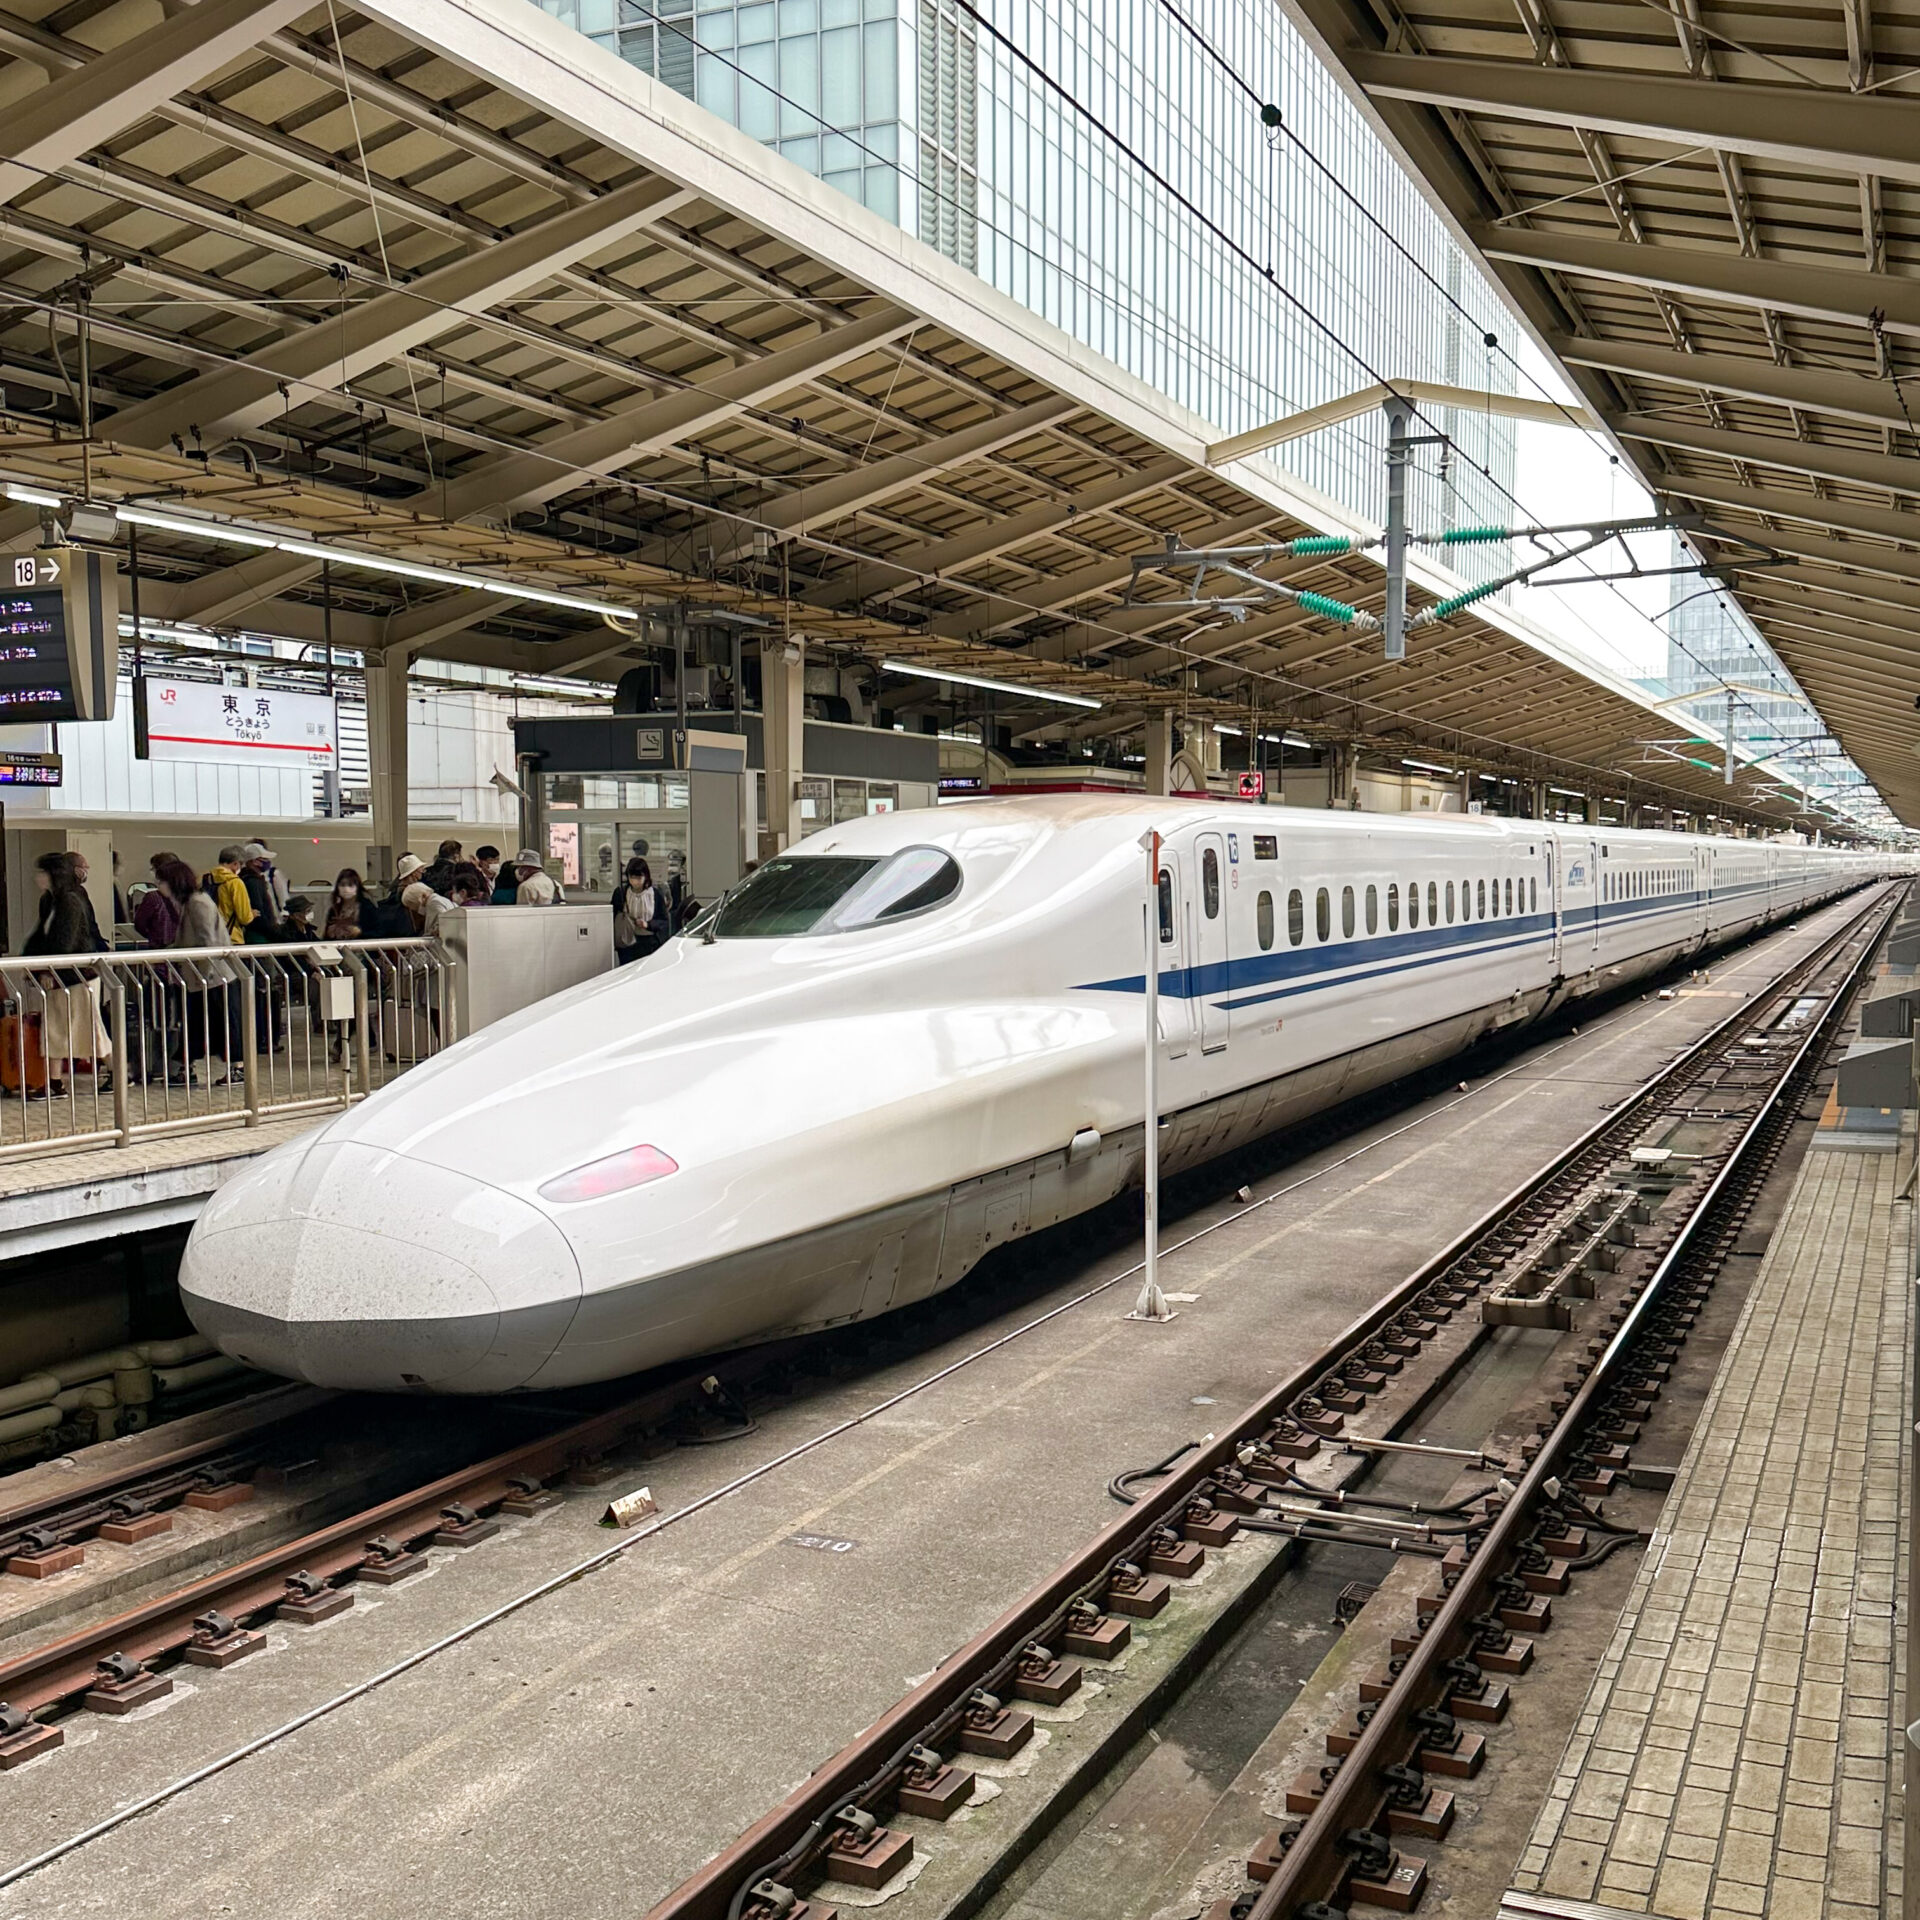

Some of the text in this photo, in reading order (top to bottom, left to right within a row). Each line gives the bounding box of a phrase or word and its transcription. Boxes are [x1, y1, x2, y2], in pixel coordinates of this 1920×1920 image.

[17, 562, 33, 583] 18
[160, 689, 176, 701] JR
[222, 695, 271, 716] 東京
[226, 716, 271, 729] とうきょう
[676, 732, 684, 741] 16
[1229, 836, 1238, 860] 16
